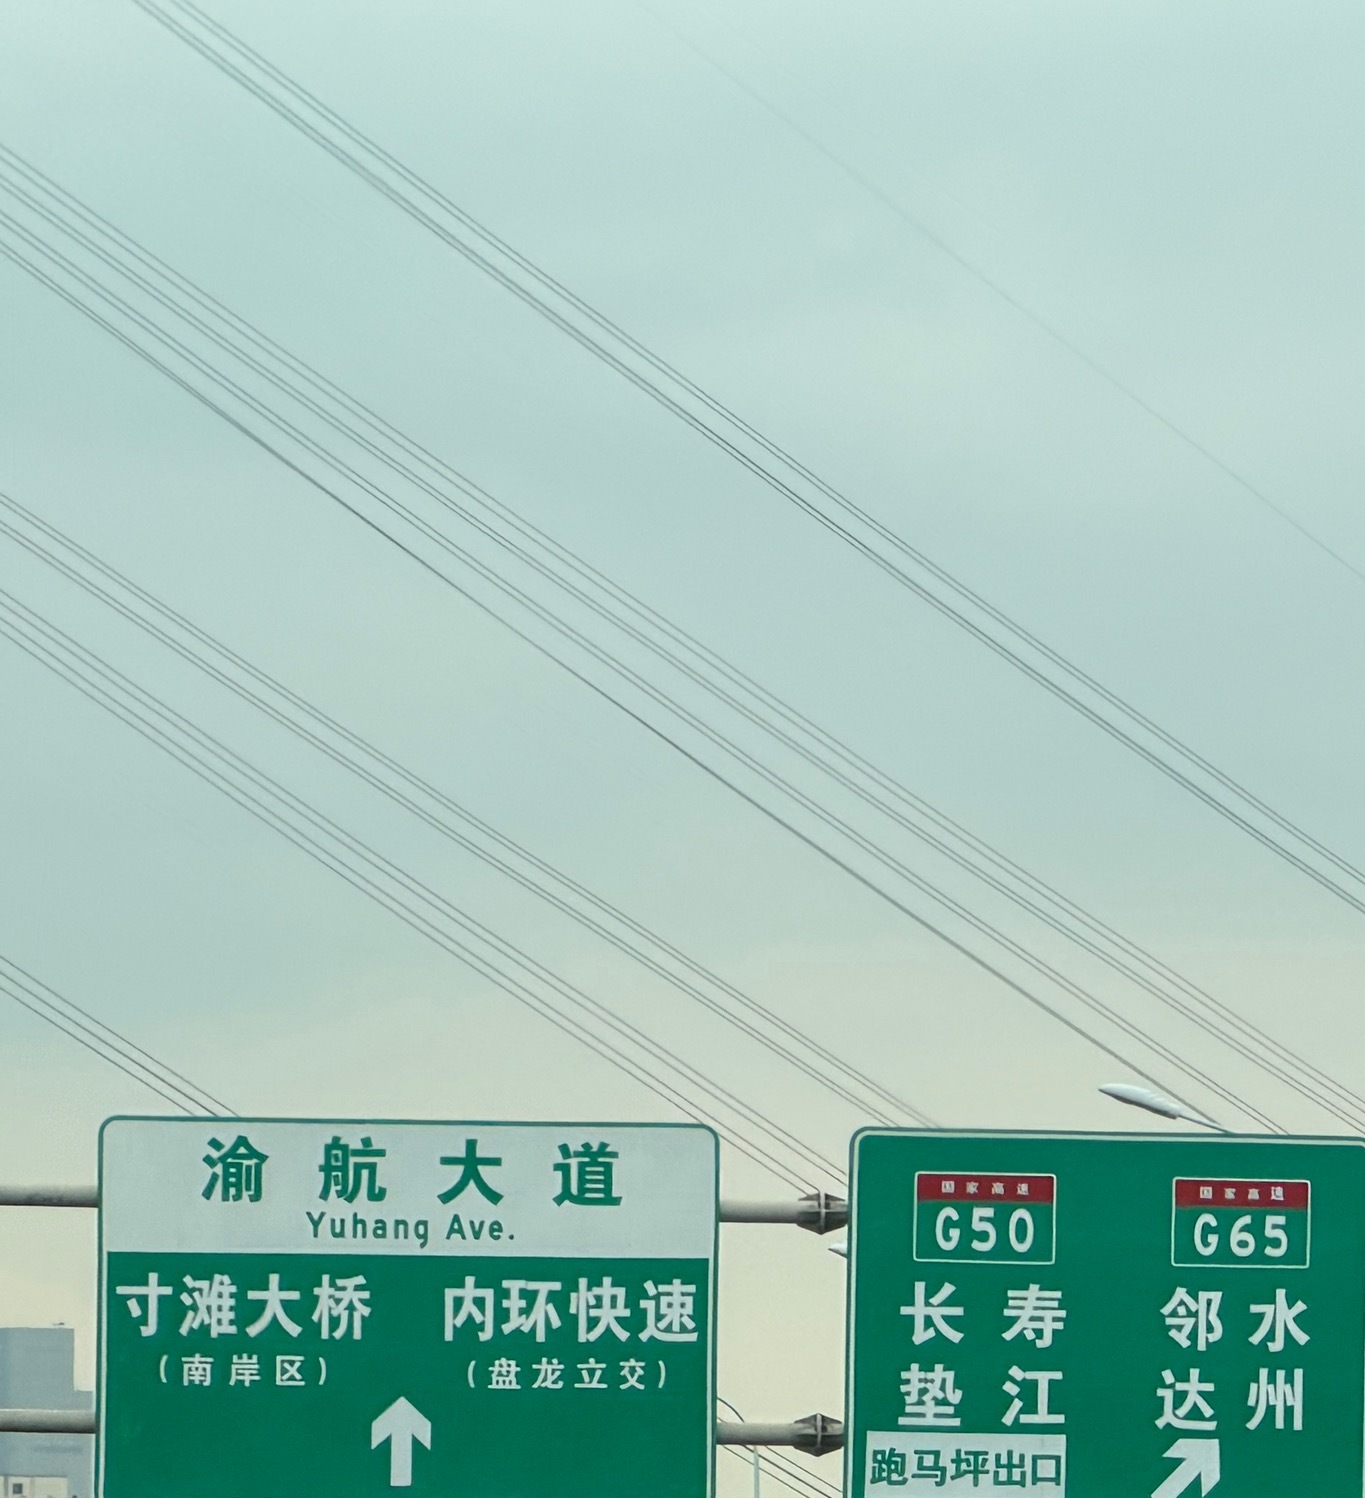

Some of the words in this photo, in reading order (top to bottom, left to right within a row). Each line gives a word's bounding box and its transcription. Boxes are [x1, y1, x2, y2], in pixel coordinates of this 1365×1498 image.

[201, 1135, 623, 1207] 渝航大道
[305, 1211, 429, 1249] Yuhang
[445, 1213, 515, 1241] Ave.
[935, 1206, 1034, 1253] G50
[1193, 1213, 1288, 1258] G65
[115, 1272, 372, 1340] 寸滩大桥
[444, 1275, 699, 1343] 内环快速
[899, 1281, 1067, 1349] 长寿
[1159, 1286, 1311, 1353] 邻水
[897, 1362, 1066, 1427] 垫江
[1154, 1367, 1304, 1431] 达州
[869, 1447, 1062, 1489] 跑马坪出口
